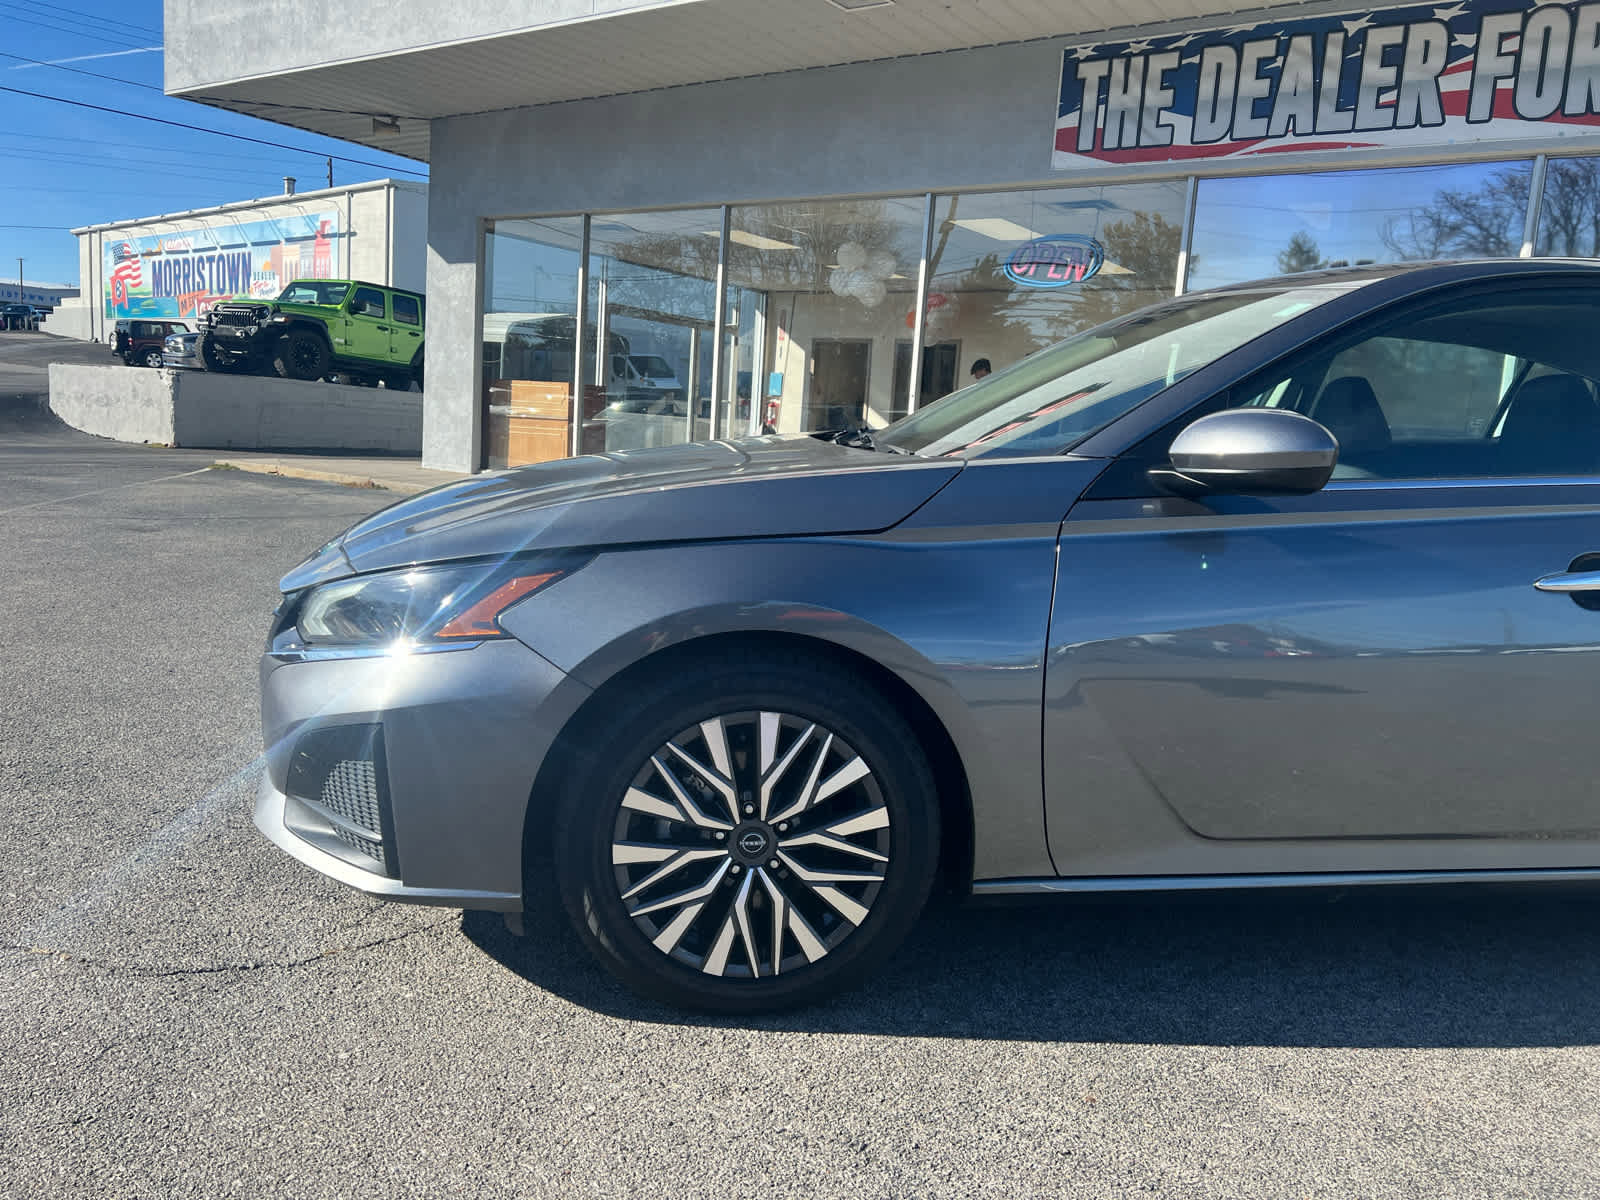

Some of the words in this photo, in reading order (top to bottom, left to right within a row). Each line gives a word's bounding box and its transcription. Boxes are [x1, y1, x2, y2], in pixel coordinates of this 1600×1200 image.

[1076, 49, 1181, 153] THE
[1190, 18, 1450, 145] DEALER
[1465, 1, 1600, 125] FOR
[151, 251, 252, 298] MORRISTOWN
[1012, 242, 1092, 281] OPEN
